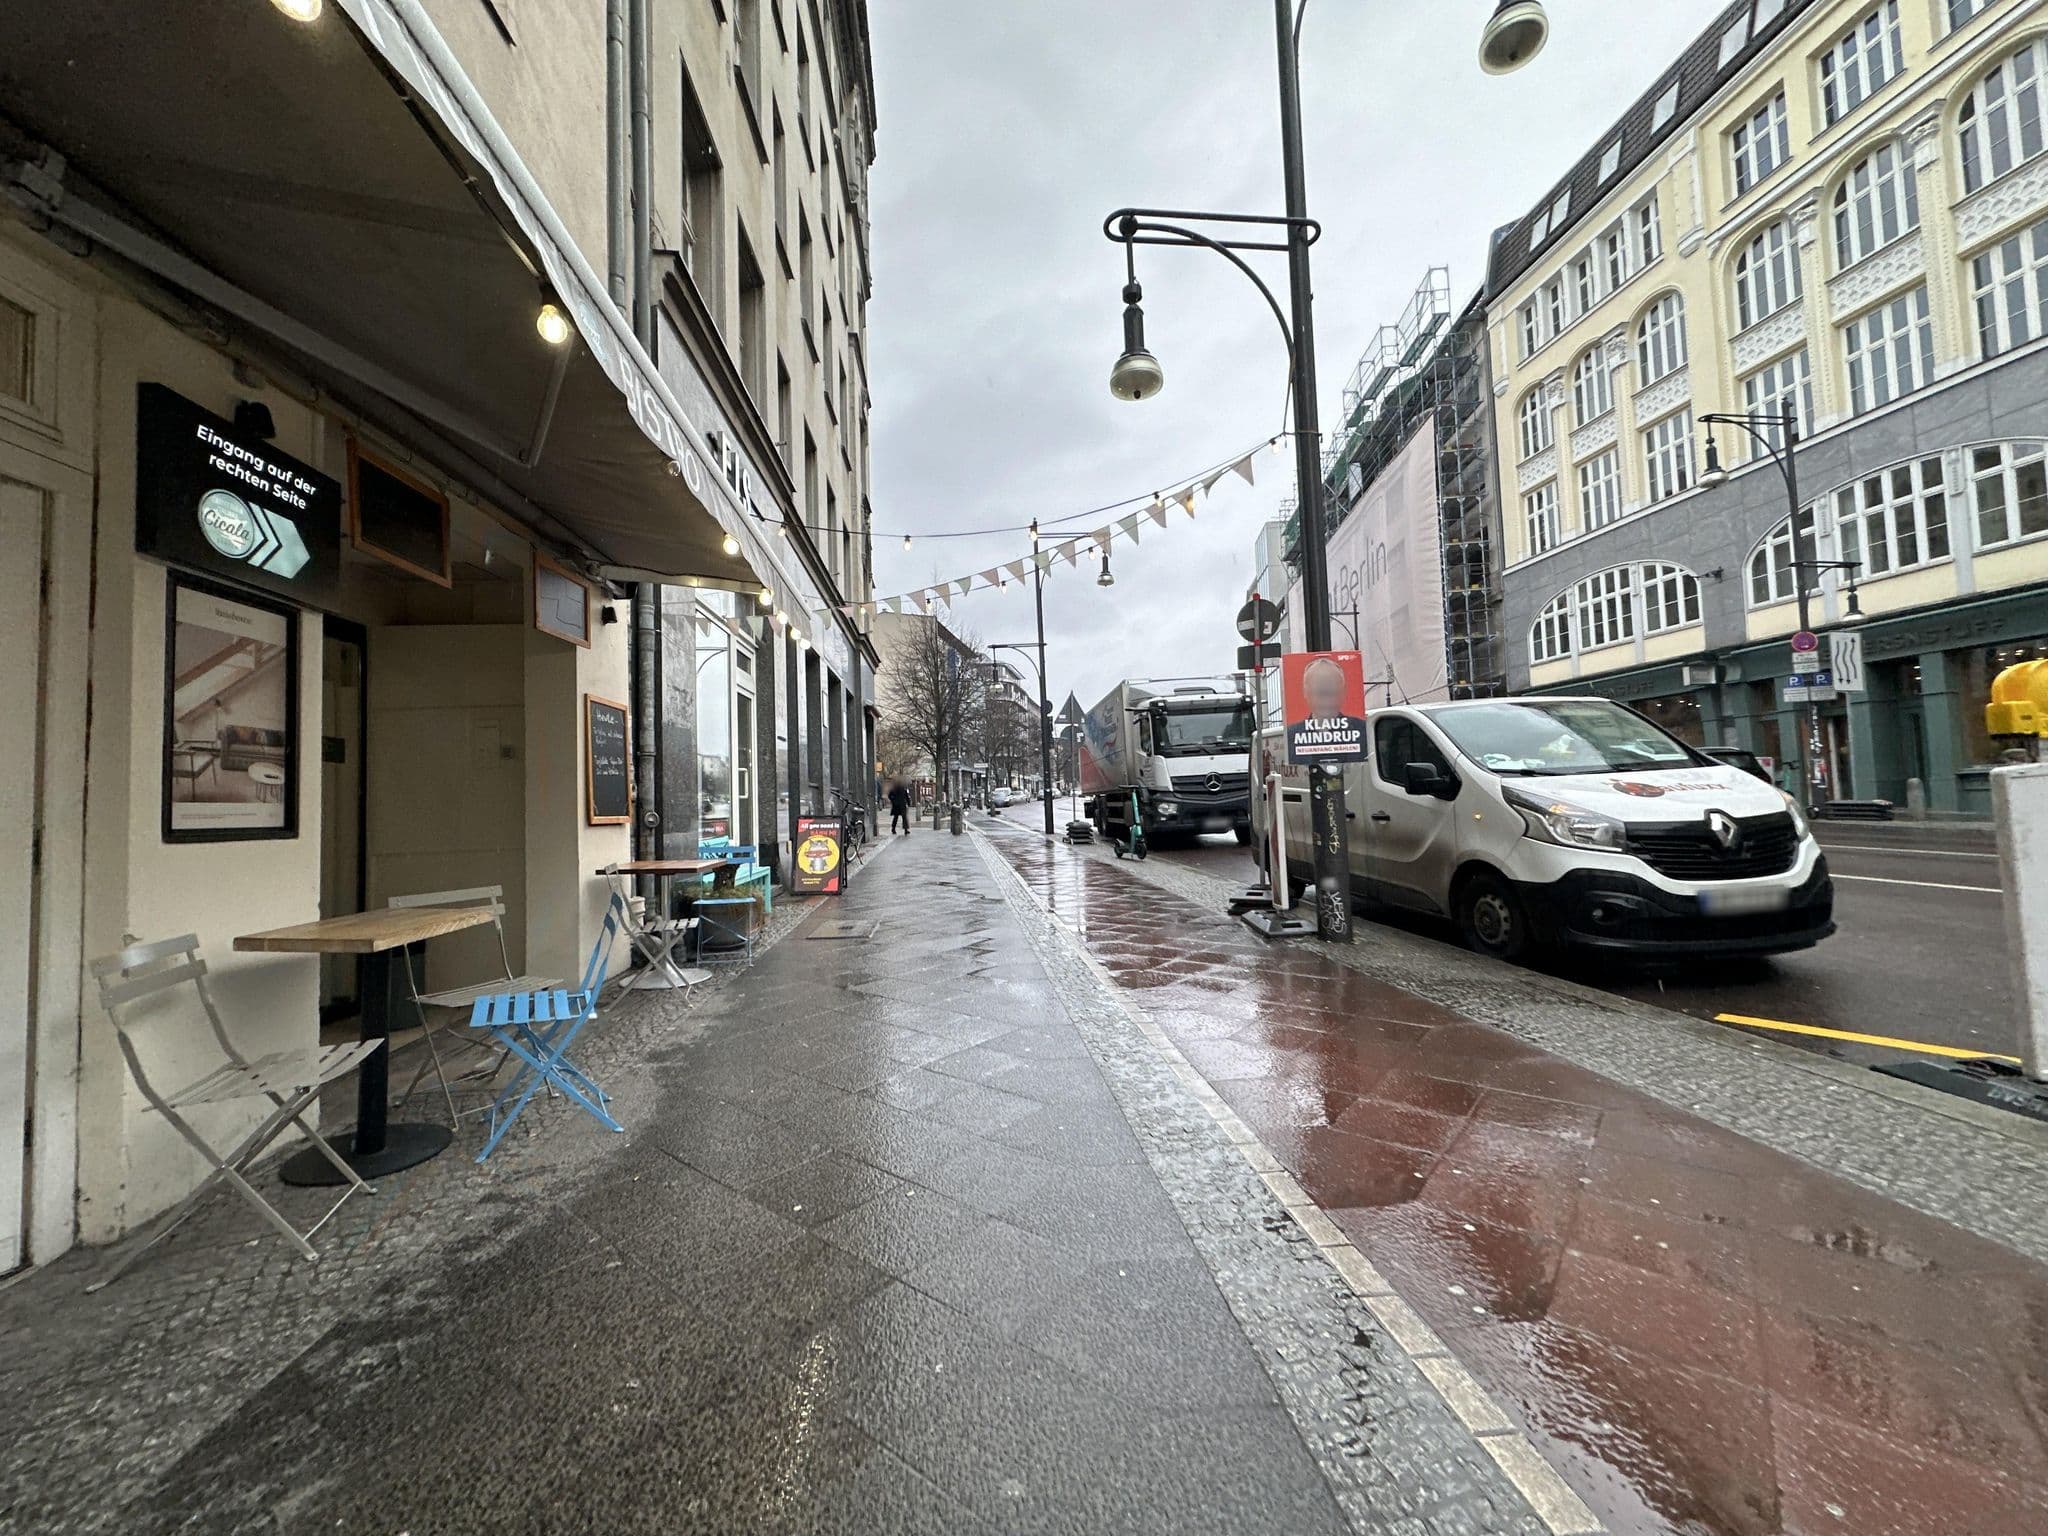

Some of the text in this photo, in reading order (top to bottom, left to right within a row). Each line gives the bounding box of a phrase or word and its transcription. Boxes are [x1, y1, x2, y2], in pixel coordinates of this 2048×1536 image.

[618, 351, 700, 493] BISTRO
[197, 424, 317, 496] Eingang auf der
[209, 454, 270, 492] rechten
[272, 483, 306, 510] Seite
[204, 509, 250, 541] Cicala
[1294, 730, 1360, 744] MINDRUP
[1304, 717, 1349, 731] KLAUS
